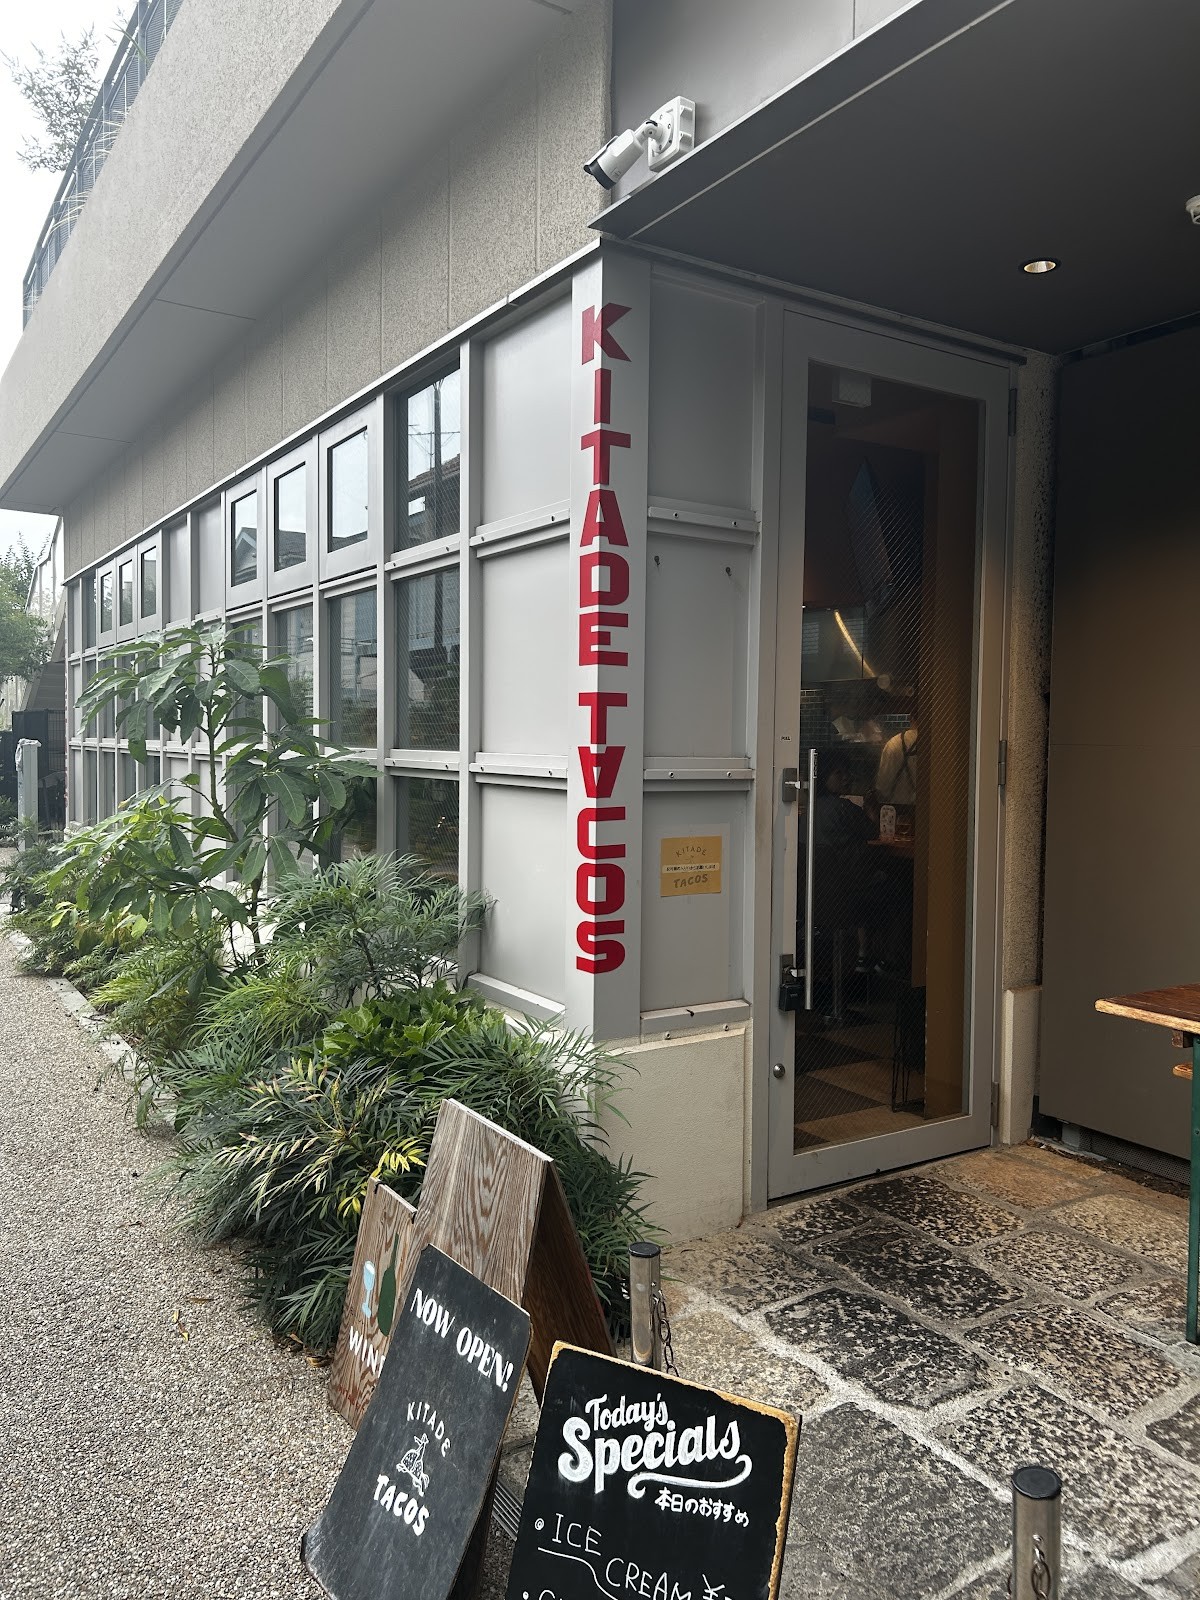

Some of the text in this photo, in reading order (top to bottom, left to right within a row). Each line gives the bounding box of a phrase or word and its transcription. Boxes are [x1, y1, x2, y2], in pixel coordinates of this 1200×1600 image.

[576, 302, 633, 974] KITADE TACOS
[675, 846, 707, 857] KITADE
[673, 873, 709, 888] TACOS
[410, 1288, 514, 1392] NOW OPEN!
[407, 1401, 451, 1458] KITADE
[585, 1392, 669, 1432] Today's
[557, 1414, 742, 1495] Specials
[373, 1474, 430, 1536] TACOS
[654, 1486, 750, 1527] 本日のおすすめ
[552, 1512, 602, 1556] ICE
